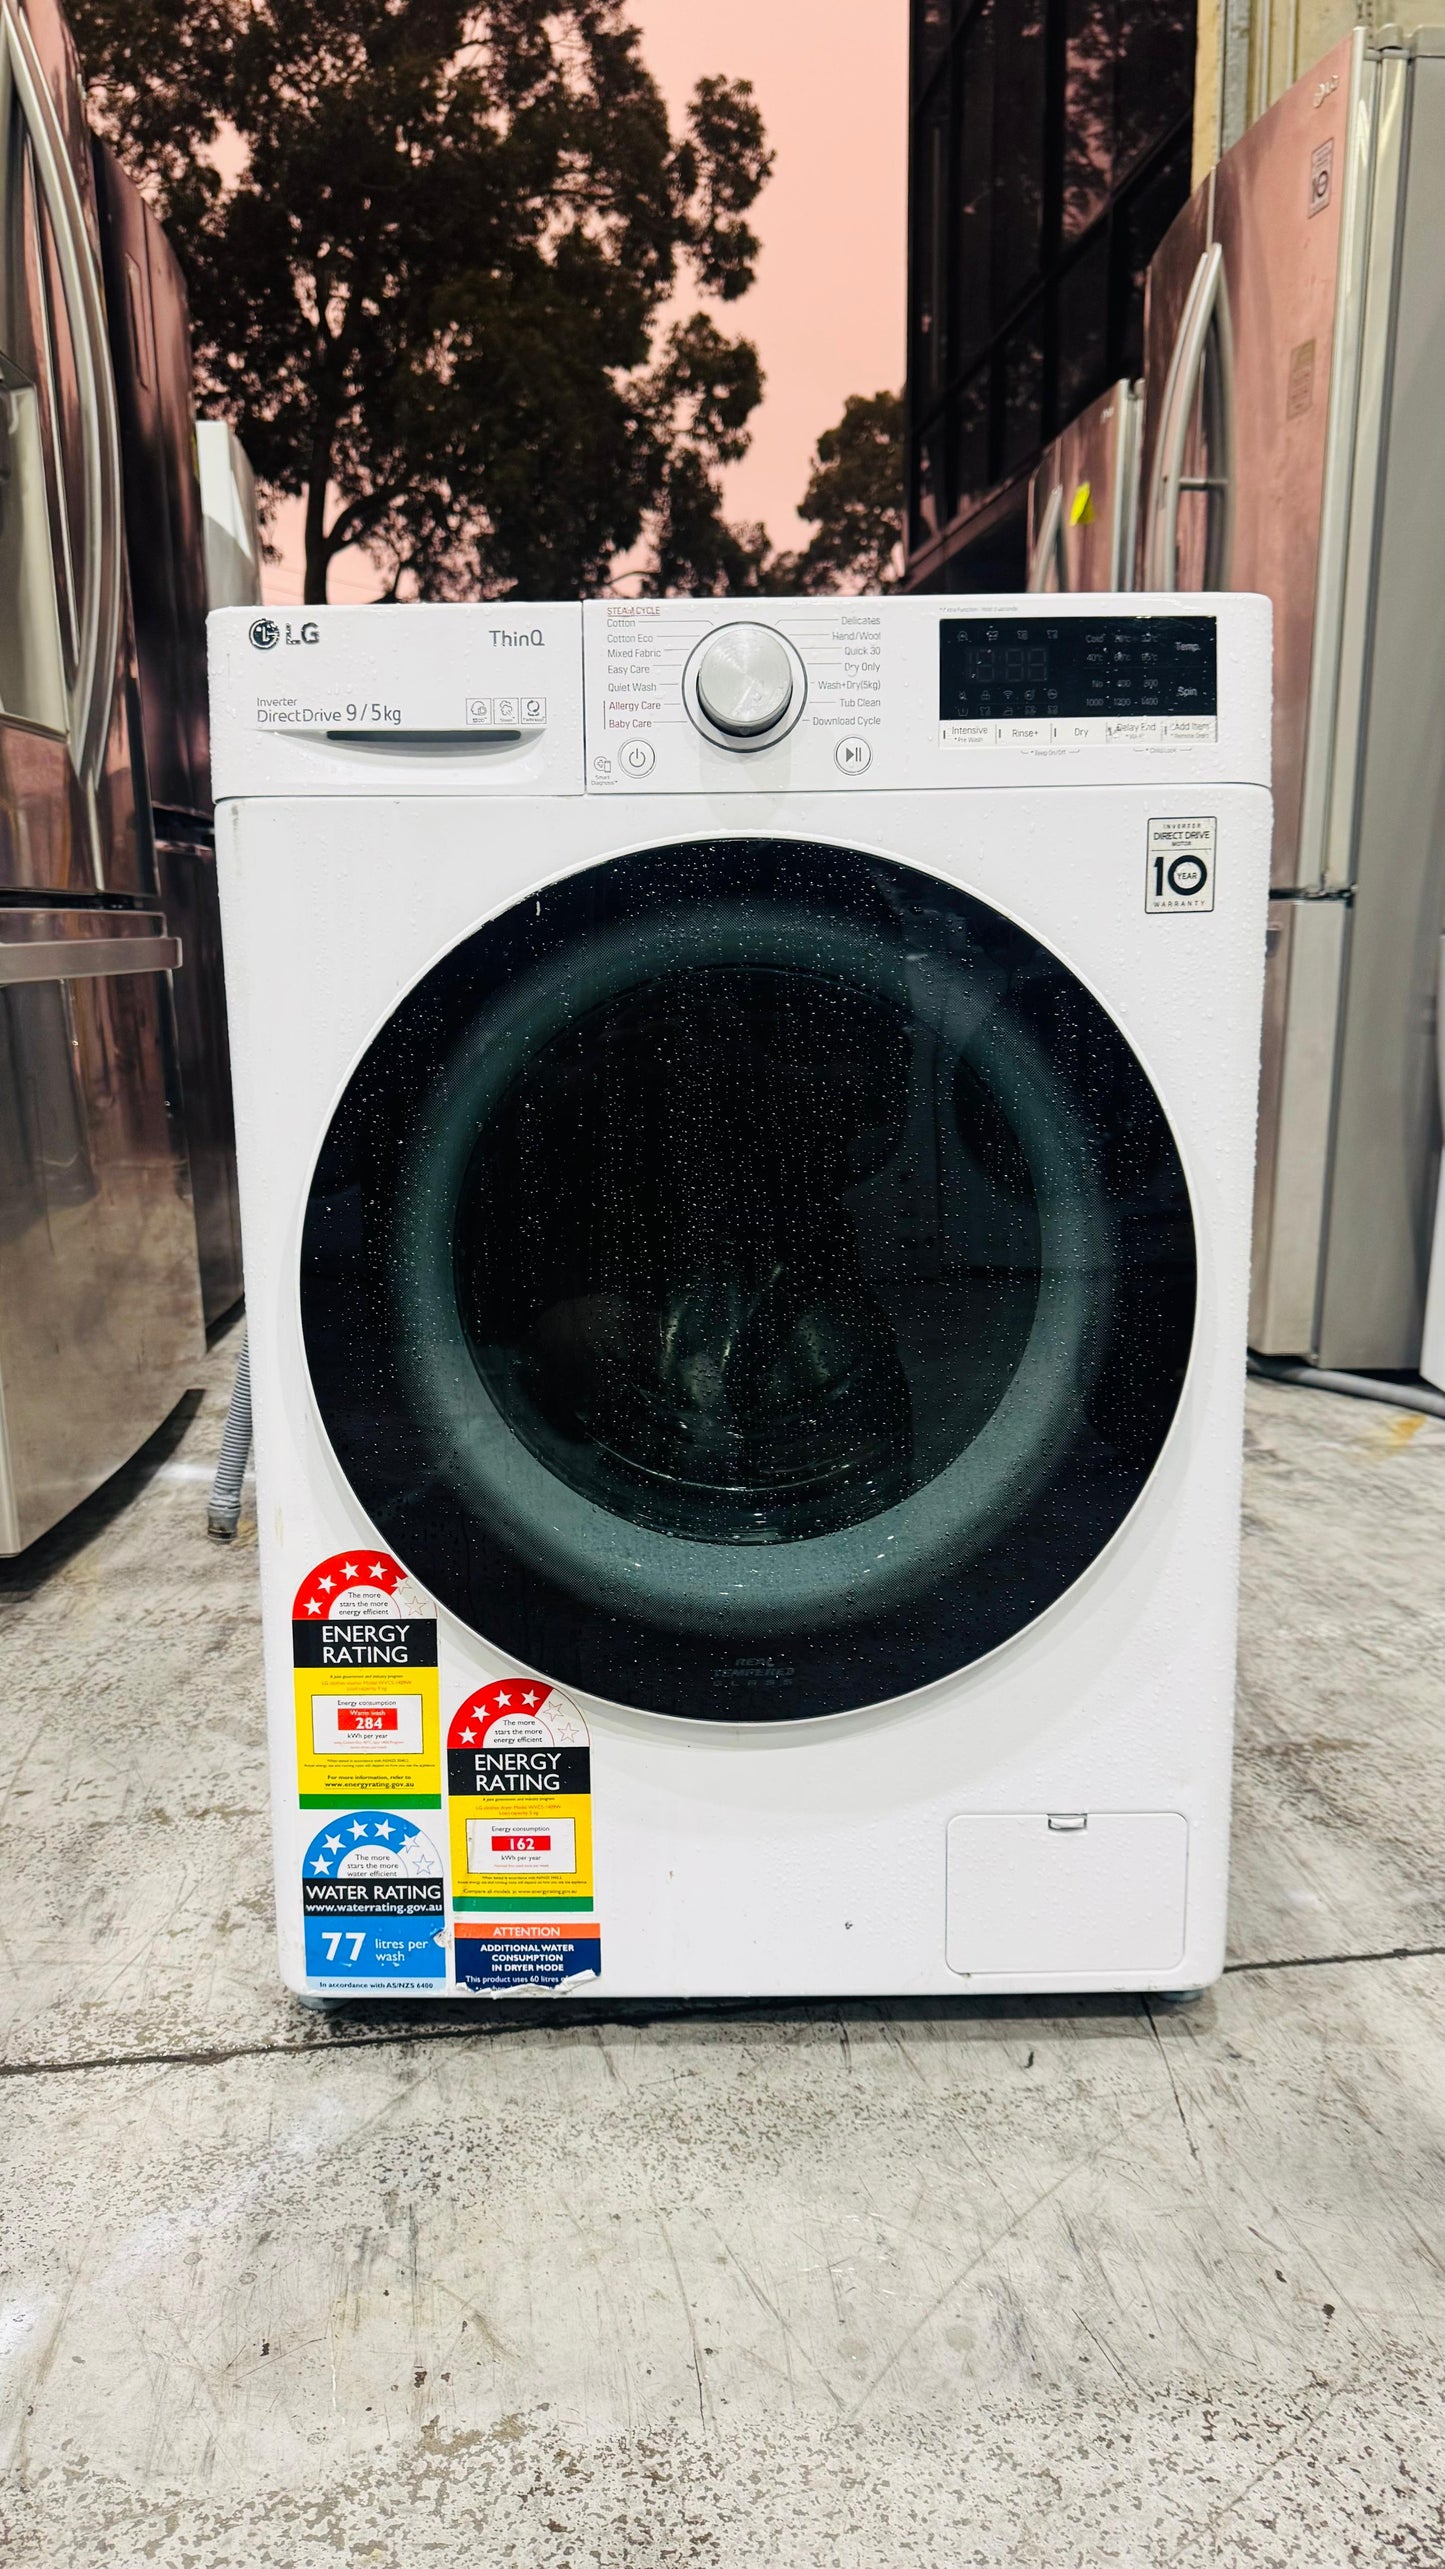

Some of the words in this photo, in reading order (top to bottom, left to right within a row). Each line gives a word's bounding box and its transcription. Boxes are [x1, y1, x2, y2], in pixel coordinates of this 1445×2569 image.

[636, 606, 661, 615] CYCLE
[607, 619, 636, 628] Cotton
[841, 616, 881, 625] Delicates
[285, 622, 320, 645] LG
[488, 629, 545, 647] ThinQ
[607, 634, 636, 643] Cotton
[638, 634, 654, 643] Eco
[832, 631, 881, 640] Hand/Wool
[608, 649, 633, 658] Mixed
[635, 649, 662, 658] Fabric
[845, 646, 868, 656] Quick
[870, 646, 881, 655] 30
[608, 665, 628, 676] Easy
[630, 664, 650, 674] Care
[844, 662, 859, 672] Dry
[862, 662, 881, 673] Only
[608, 683, 630, 692] Quiet
[632, 683, 657, 692] Wash
[818, 680, 881, 691] Wash+Dry(5kg)
[1177, 686, 1198, 697] Spin
[257, 697, 298, 707] Inverter
[609, 701, 639, 712] Allergy
[641, 701, 661, 710] Care
[840, 698, 856, 707] Tub
[857, 698, 881, 707] Clean
[1086, 698, 1104, 706] 1000
[609, 719, 630, 730] Baby
[632, 719, 652, 728] Care
[813, 716, 856, 726] Download
[857, 716, 881, 727] Cycle
[1141, 722, 1156, 731] End
[952, 726, 988, 735] Intensive
[1173, 723, 1190, 731] Add
[1012, 728, 1039, 738] Rinse+
[1074, 727, 1089, 738] Dry
[1153, 831, 1183, 840] DIRECT
[1185, 830, 1211, 840] DRIVE
[1153, 854, 1208, 896] 10
[1177, 872, 1198, 880] YEAR
[1153, 900, 1206, 908] WARRANTY
[348, 1591, 361, 1599] The
[338, 1609, 361, 1617] energy
[322, 1625, 411, 1643] ENERGY
[323, 1645, 409, 1664] RATING
[355, 1717, 383, 1729] 284
[493, 1737, 516, 1745] energy
[474, 1753, 562, 1771] ENERGY
[325, 1781, 415, 1789] www.energyrating.gov.au
[476, 1774, 560, 1792] RATING
[509, 1838, 535, 1850] 162
[355, 1853, 369, 1861] The
[305, 1885, 369, 1899] WATER
[373, 1884, 441, 1899] RATING
[305, 1902, 443, 1914] www.waterrating.gov.au
[493, 1926, 561, 1937] ATTENTION
[321, 1932, 367, 1961] 77
[375, 1938, 404, 1949] litres
[408, 1940, 429, 1952] per
[480, 1944, 541, 1952] ADDITIONAL
[542, 1944, 574, 1952] WATER
[375, 1950, 405, 1961] wash
[491, 1954, 564, 1962] CONSUMPTION
[491, 1964, 502, 1972] IN
[504, 1963, 534, 1972] DRYER
[536, 1963, 564, 1971] MODE
[465, 1975, 481, 1983] This
[482, 1975, 512, 1984] product
[530, 1975, 540, 1983] 60
[540, 1975, 559, 1983] litres
